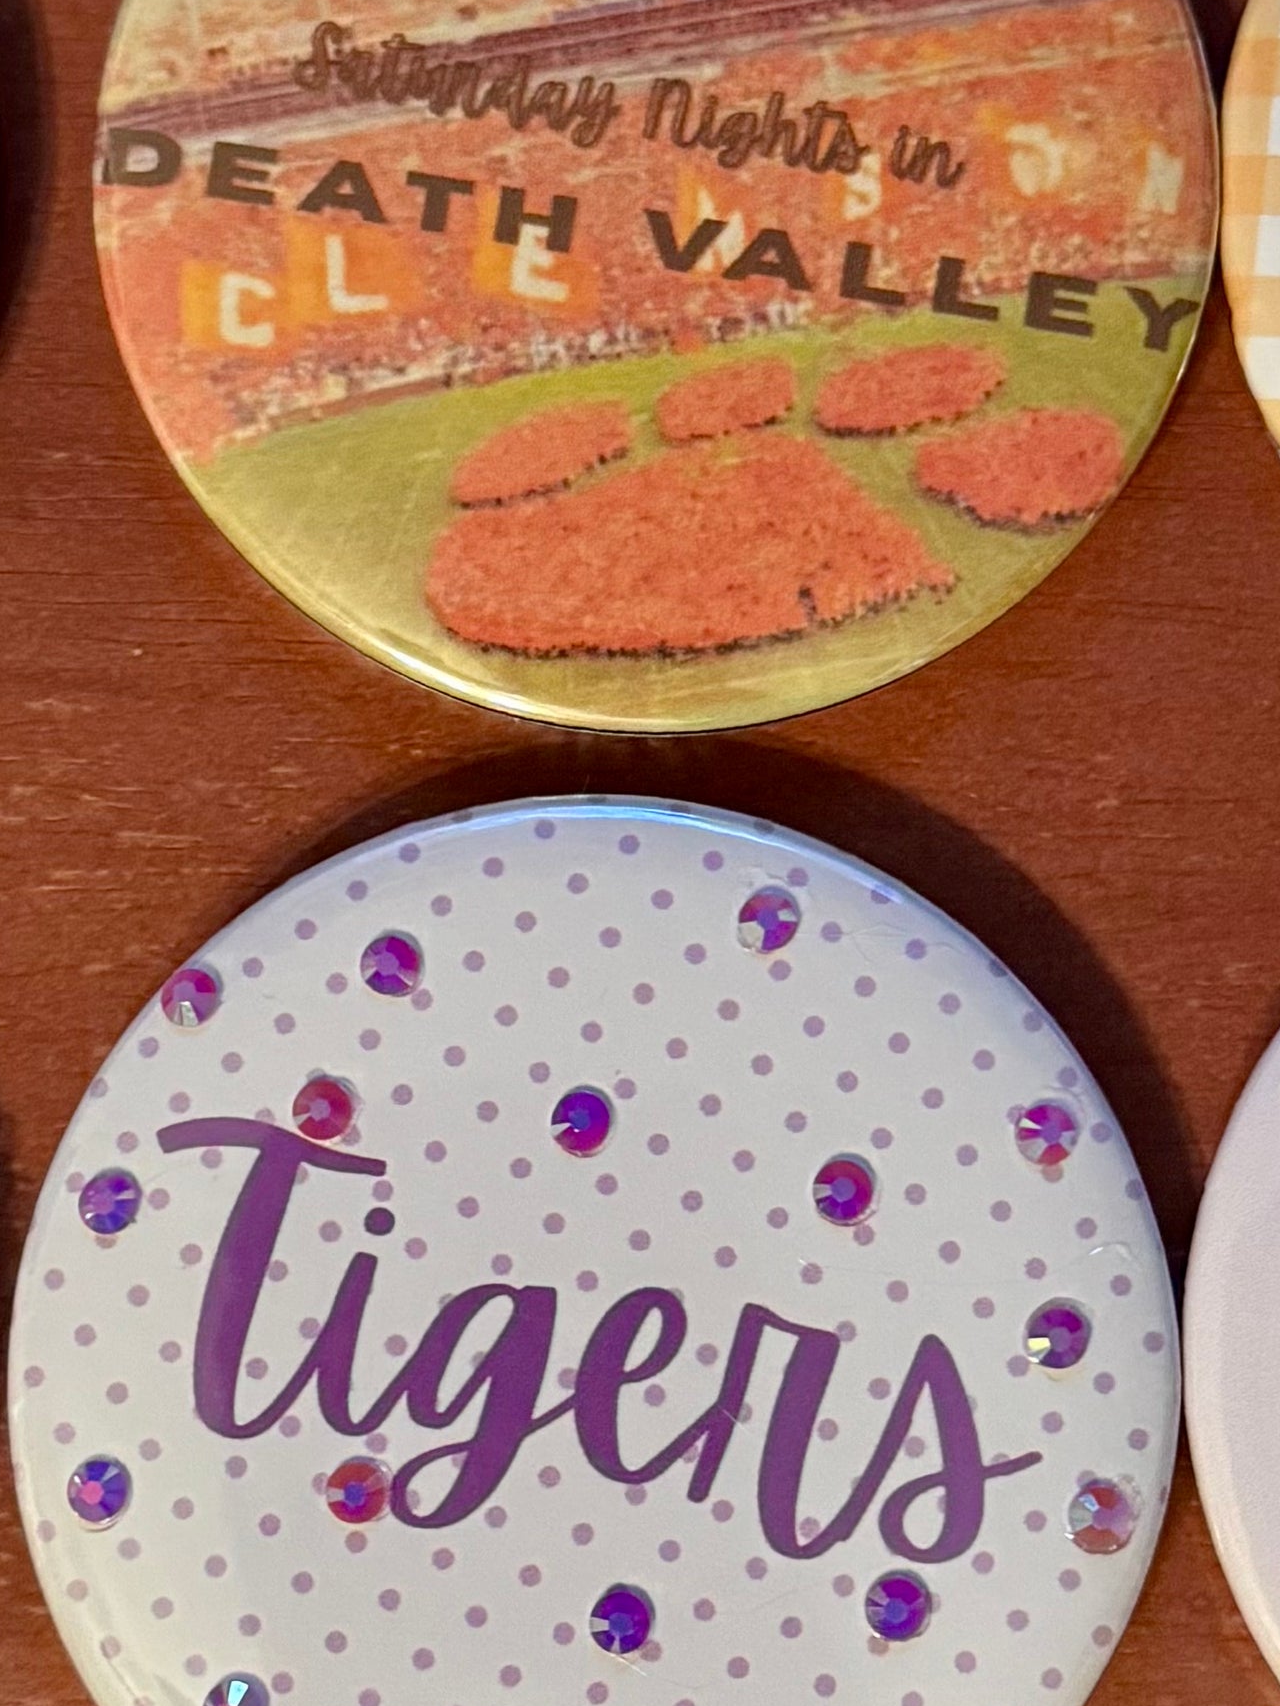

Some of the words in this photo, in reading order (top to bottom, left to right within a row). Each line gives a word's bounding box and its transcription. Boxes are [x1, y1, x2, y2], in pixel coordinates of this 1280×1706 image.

[294, 22, 618, 147] Saturday
[643, 77, 869, 174] Nights
[888, 124, 965, 189] in
[101, 128, 578, 253] DEATH
[643, 208, 1200, 353] VALLEY
[156, 1116, 1042, 1562] Tigers
